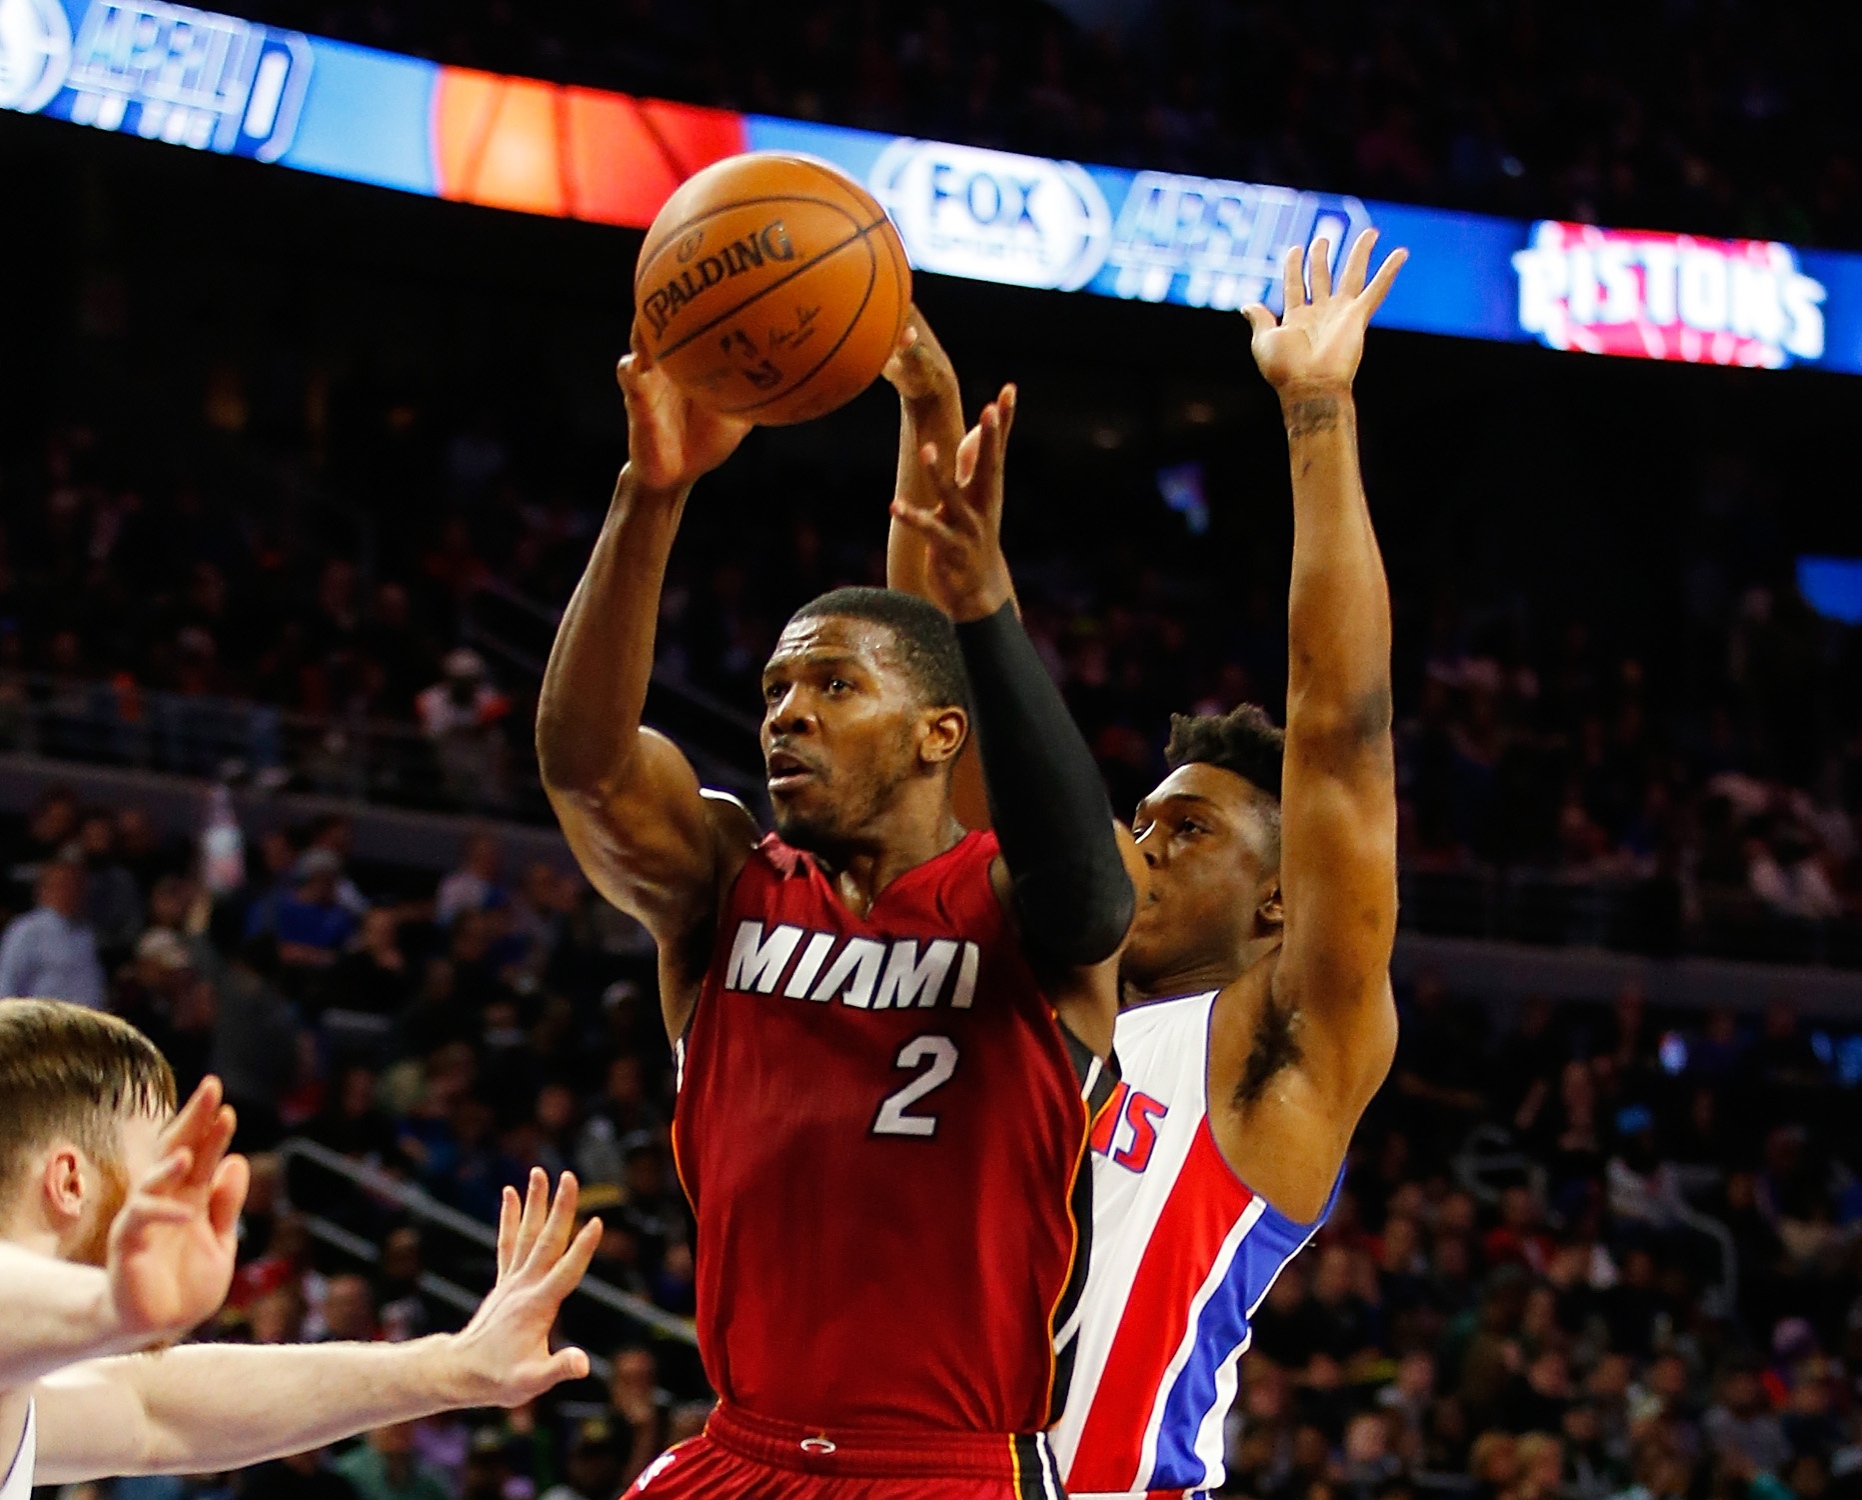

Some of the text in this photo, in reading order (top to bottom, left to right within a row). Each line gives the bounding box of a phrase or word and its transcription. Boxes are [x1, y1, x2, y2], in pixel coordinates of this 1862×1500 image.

[931, 162, 1045, 242] FOX
[642, 217, 796, 343] SPALDING
[1511, 236, 1826, 359] PISTONS
[724, 919, 981, 1011] MIAMI
[871, 1034, 960, 1137] 2
